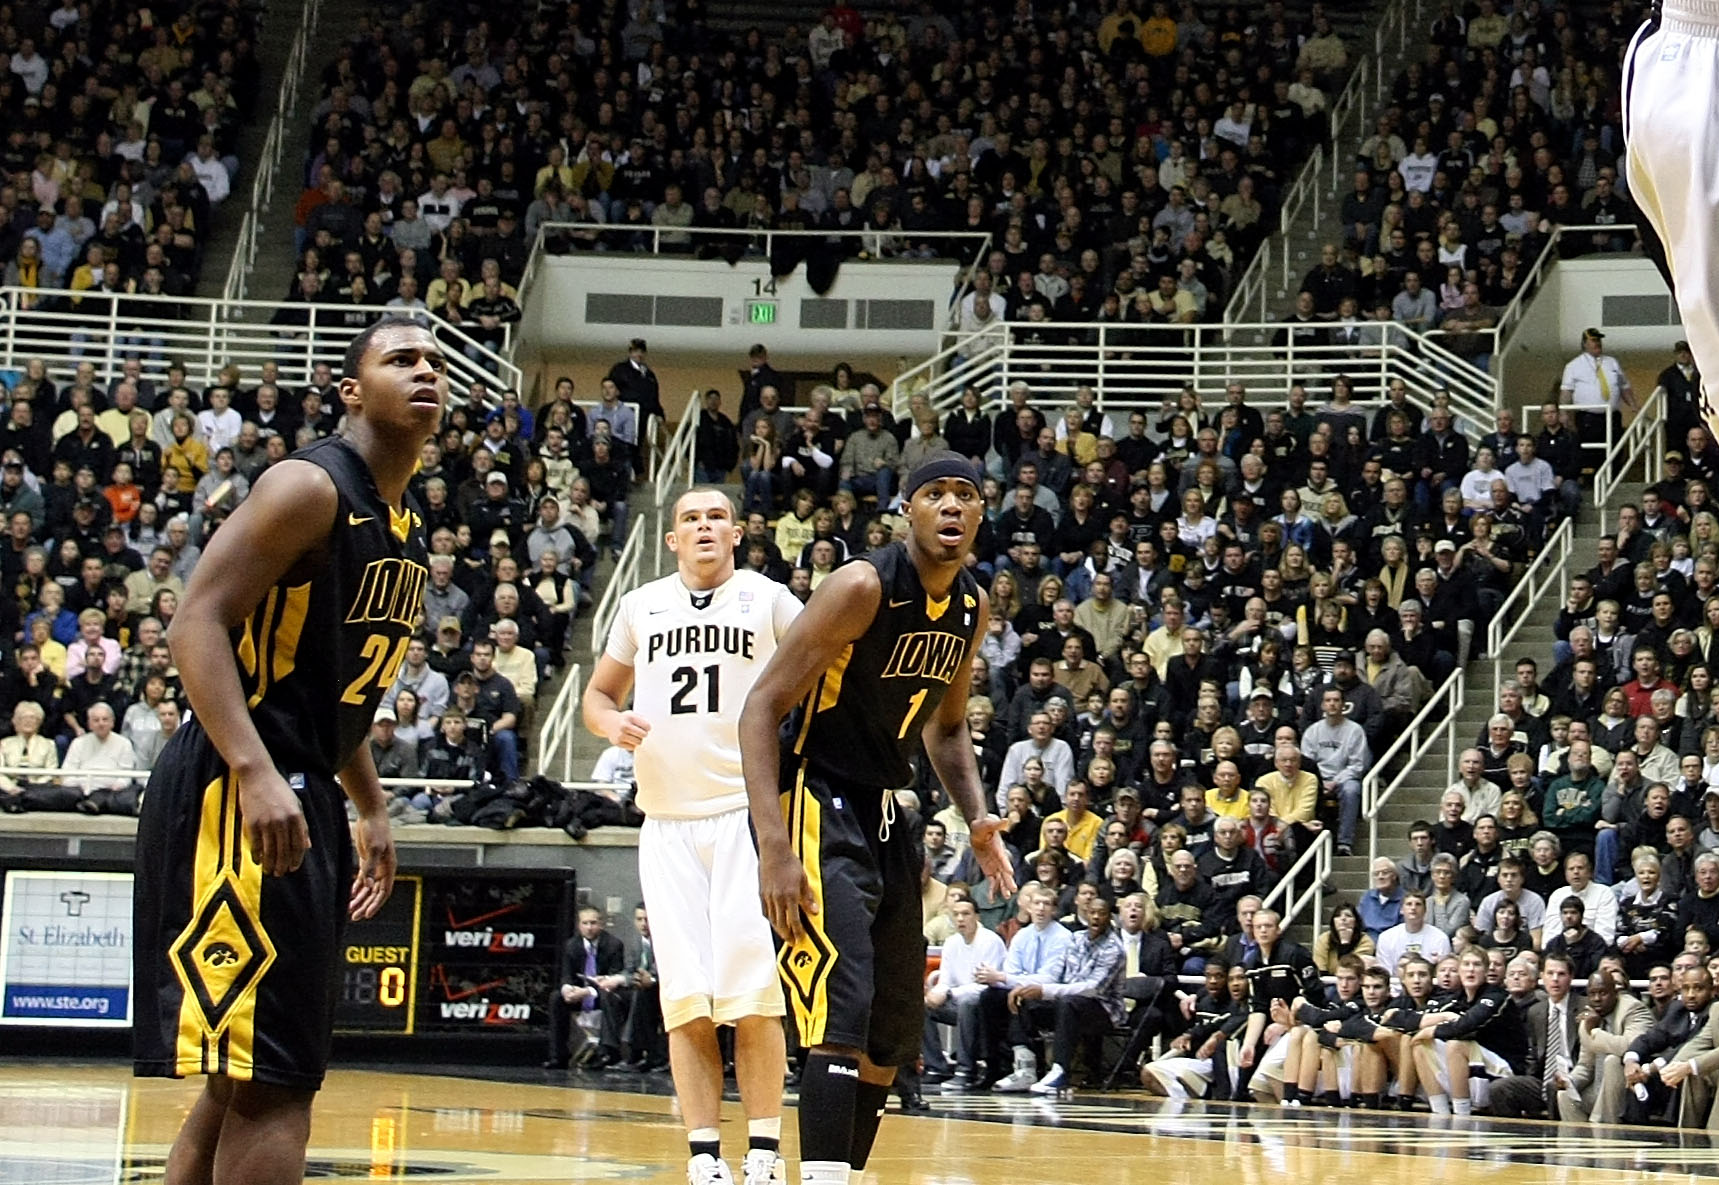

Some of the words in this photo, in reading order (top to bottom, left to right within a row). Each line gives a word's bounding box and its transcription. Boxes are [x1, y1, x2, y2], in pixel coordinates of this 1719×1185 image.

[752, 278, 777, 297] 14
[648, 624, 754, 664] PURDUE
[340, 634, 411, 705] 24
[880, 631, 966, 685] IOWA
[671, 664, 720, 715] 21
[897, 688, 929, 739] 1
[44, 925, 124, 947] Elizabeth
[445, 927, 535, 954] verizon
[345, 946, 410, 964] GUEST
[13, 995, 109, 1013] www.ste.org
[440, 998, 530, 1024] verizon
